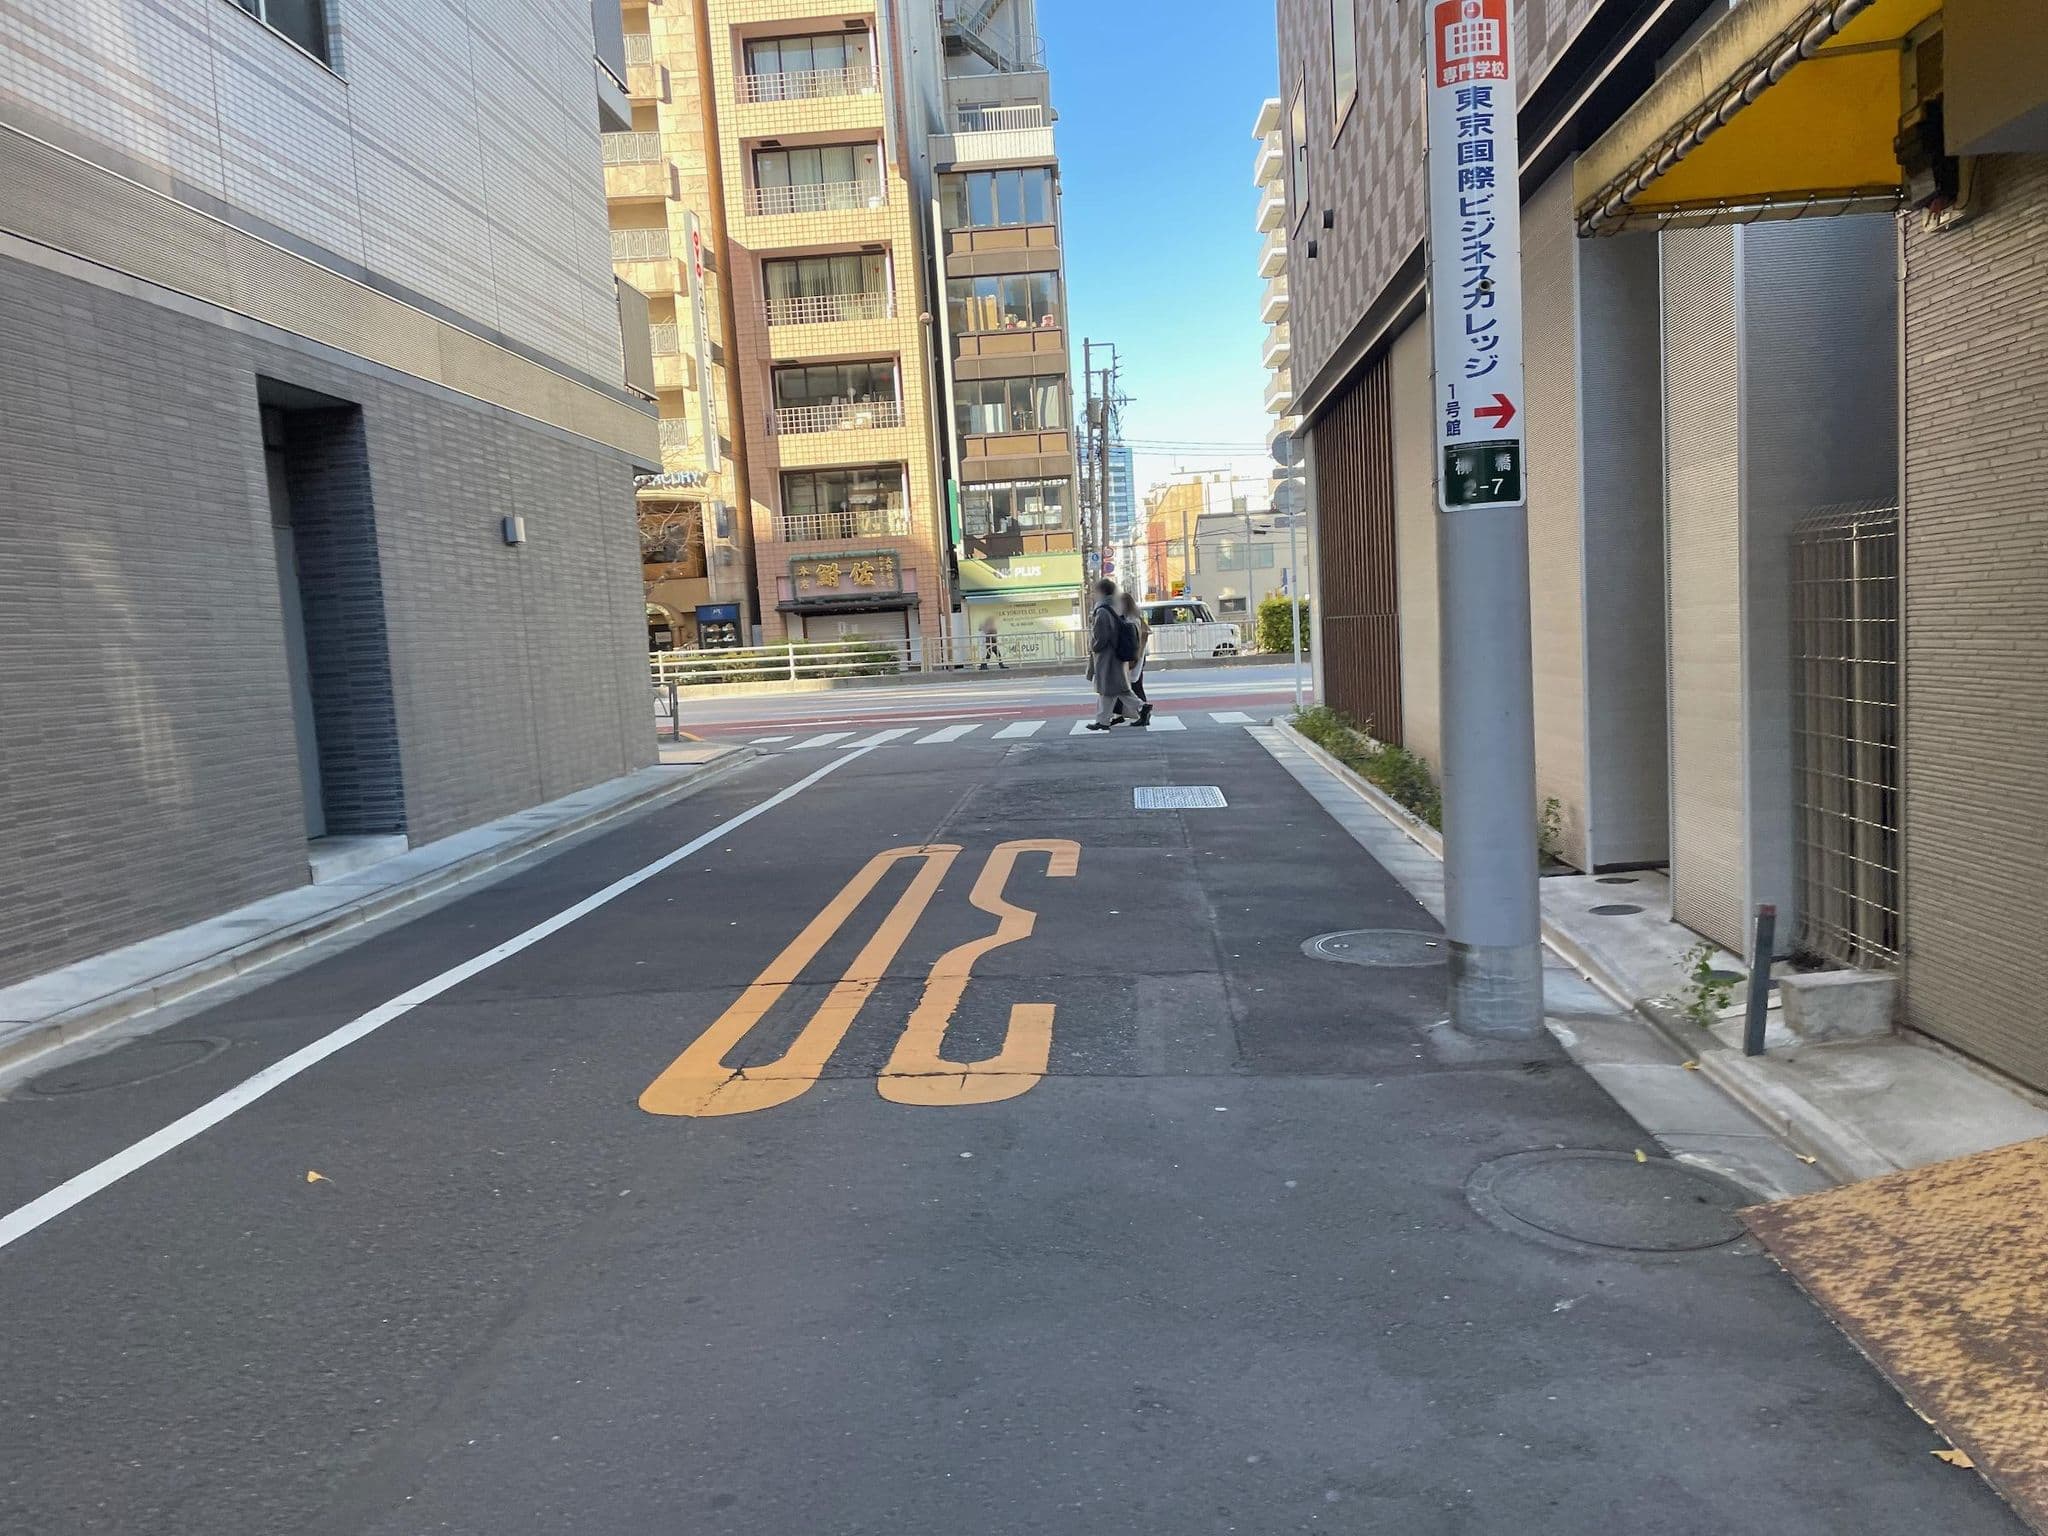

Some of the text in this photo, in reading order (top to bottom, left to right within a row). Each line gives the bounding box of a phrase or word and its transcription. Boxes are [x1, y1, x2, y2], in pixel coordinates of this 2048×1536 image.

[1442, 60, 1505, 84] 専門学校
[1455, 86, 1499, 379] 東京国際ビジネスカレッジ
[1445, 384, 1461, 437] 1号館
[1014, 565, 1042, 577] PLUS
[638, 838, 1083, 1117] 30
